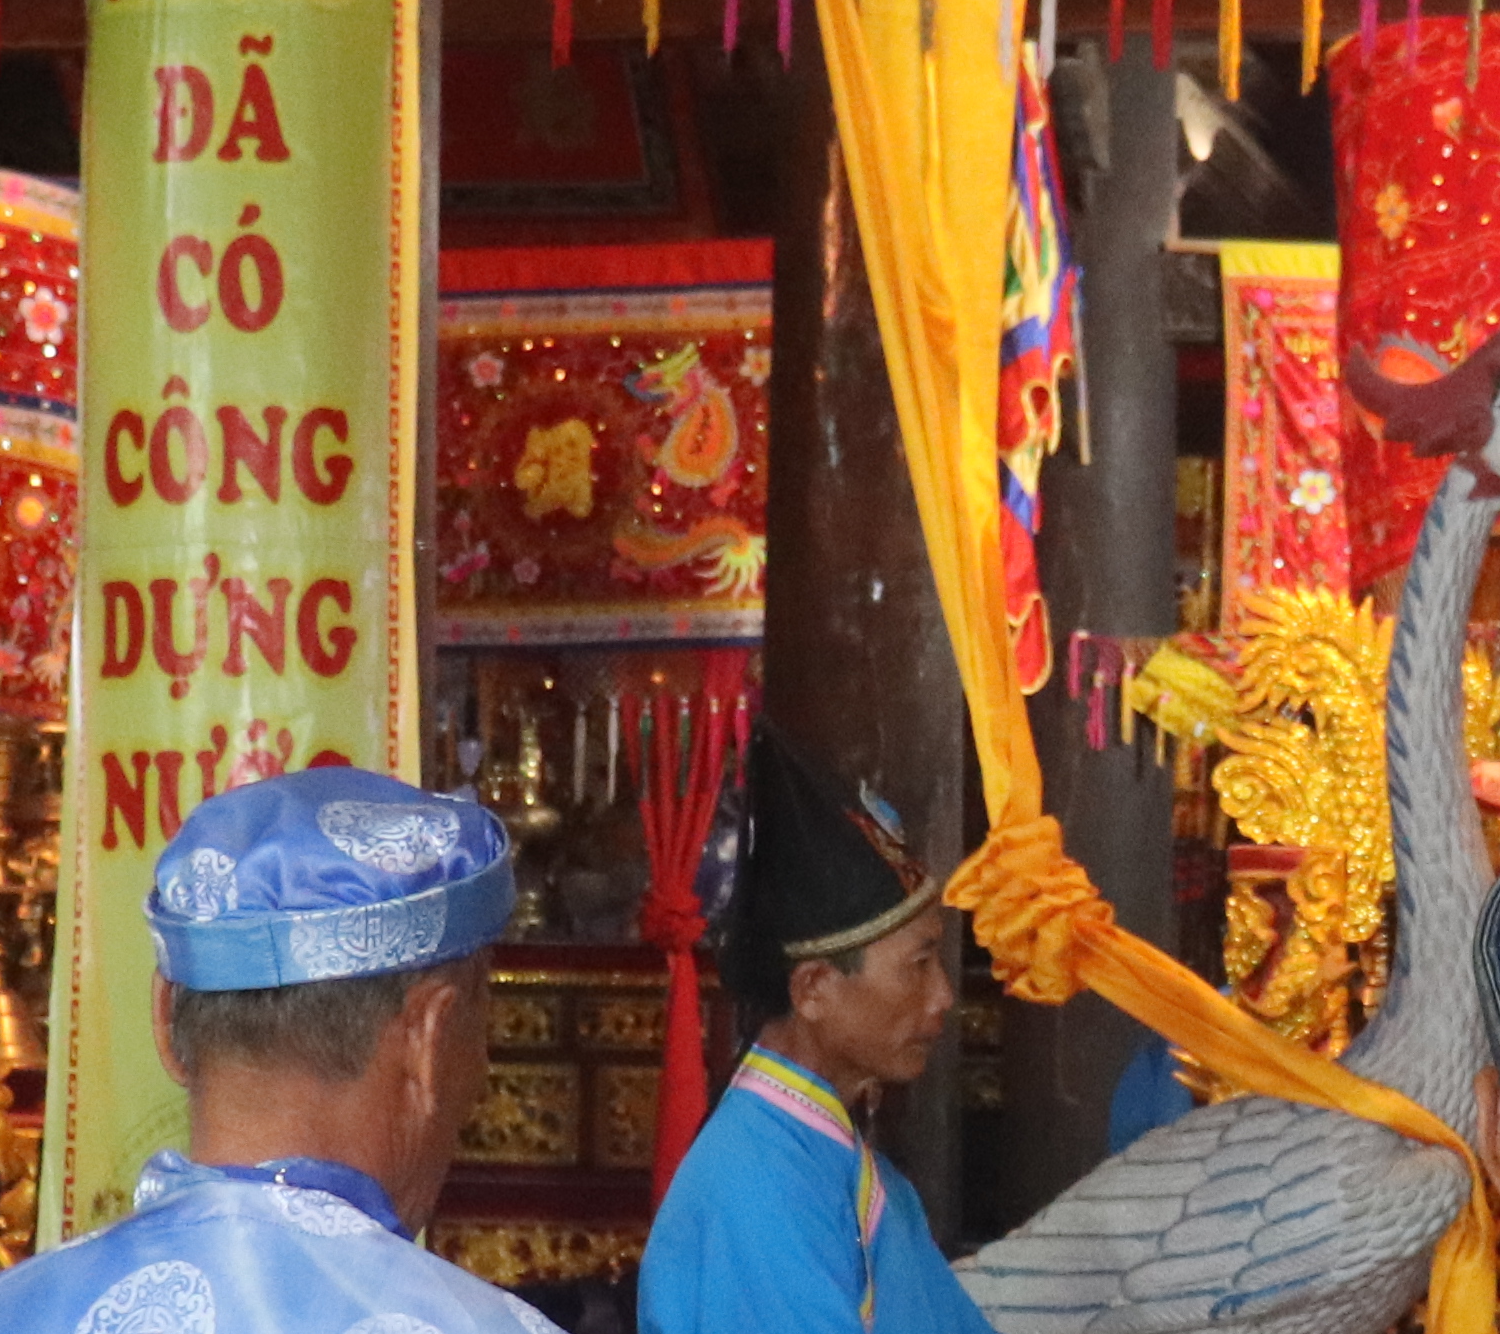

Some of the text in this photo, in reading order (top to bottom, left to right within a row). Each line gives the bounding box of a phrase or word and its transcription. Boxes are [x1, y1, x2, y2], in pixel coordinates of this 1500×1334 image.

[152, 34, 292, 164] ĐÃ
[155, 203, 286, 334] CÓ
[102, 373, 356, 509] CÔNG
[100, 552, 358, 701] DỰNG
